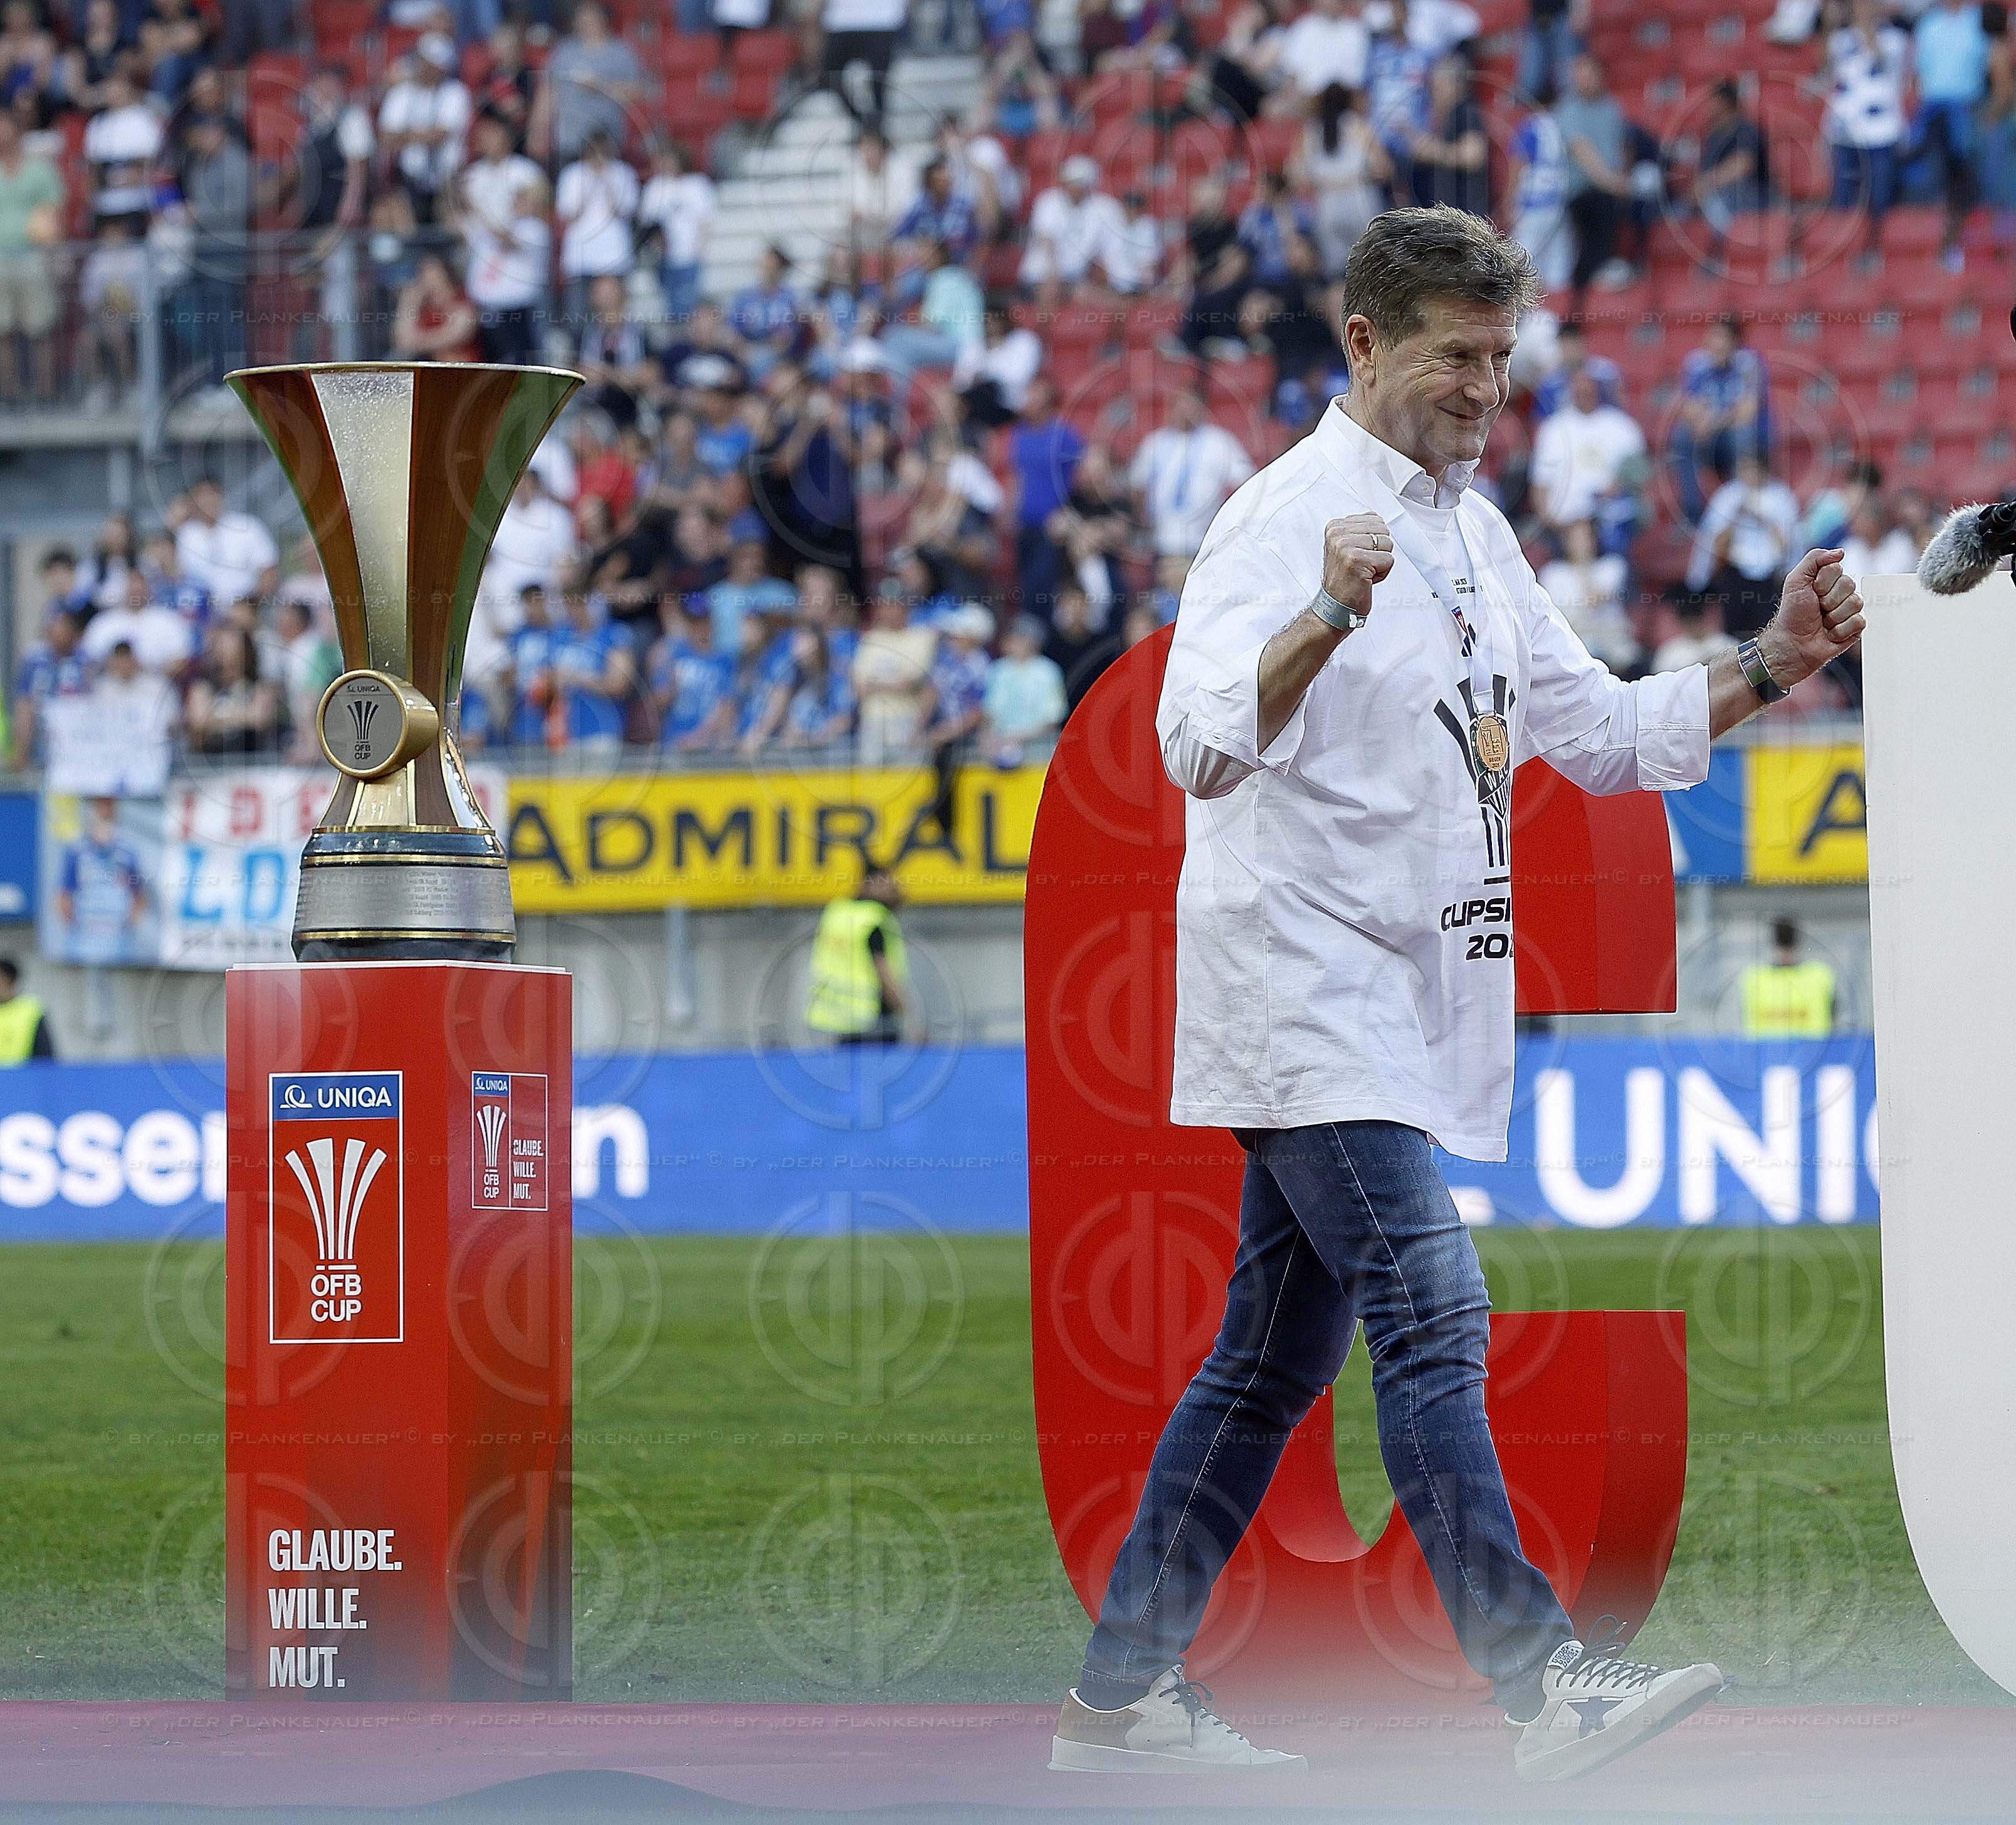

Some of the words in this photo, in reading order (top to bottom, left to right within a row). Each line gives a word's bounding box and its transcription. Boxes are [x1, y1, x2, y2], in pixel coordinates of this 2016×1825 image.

[508, 792, 1027, 886] ADMIRAL
[1466, 933, 1514, 960] 20
[486, 1079, 508, 1090] UNIQA
[318, 1087, 392, 1109] UNIQA
[513, 1139, 544, 1156] GLAUBE.
[1534, 1065, 1880, 1228] UNI
[513, 1161, 537, 1178] WILLE.
[483, 1186, 499, 1198] CUP
[513, 1183, 532, 1200] MUT.
[311, 1299, 362, 1322] CUP
[268, 1530, 402, 1571] GLAUBE.
[268, 1589, 367, 1629] WILLE.
[269, 1647, 345, 1688] MUT.
